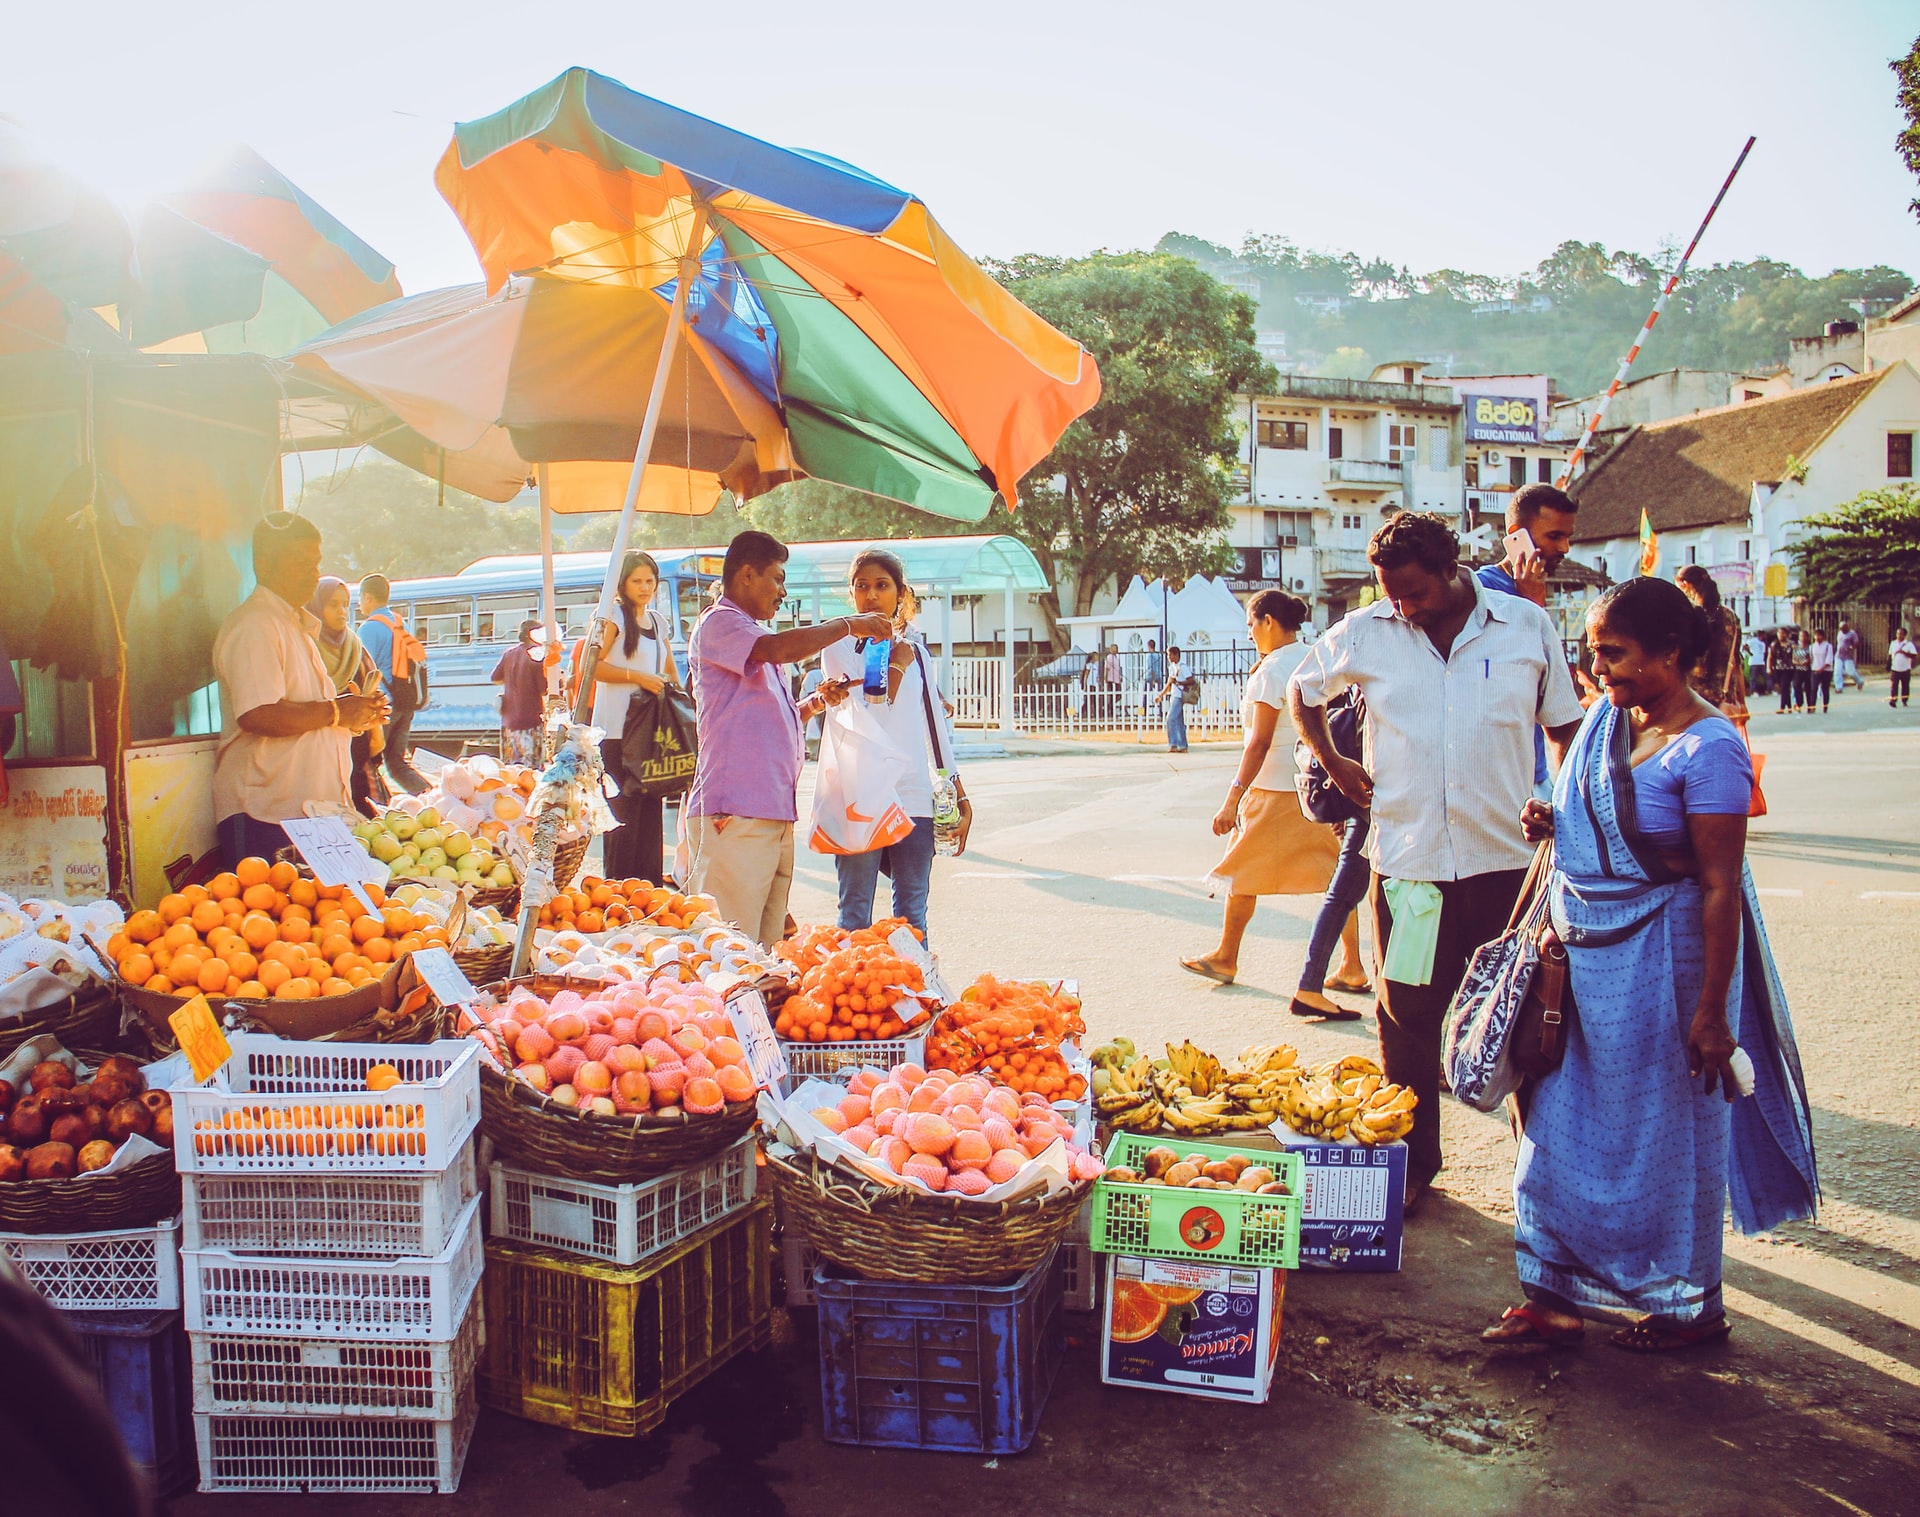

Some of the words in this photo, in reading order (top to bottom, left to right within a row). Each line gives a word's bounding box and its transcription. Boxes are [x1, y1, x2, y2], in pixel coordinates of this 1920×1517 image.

[1473, 428, 1537, 442] EDUCATIONAL
[641, 756, 696, 777] Tulips
[1300, 1222, 1348, 1240] Pomegranat
[1351, 1225, 1384, 1241] Sweet
